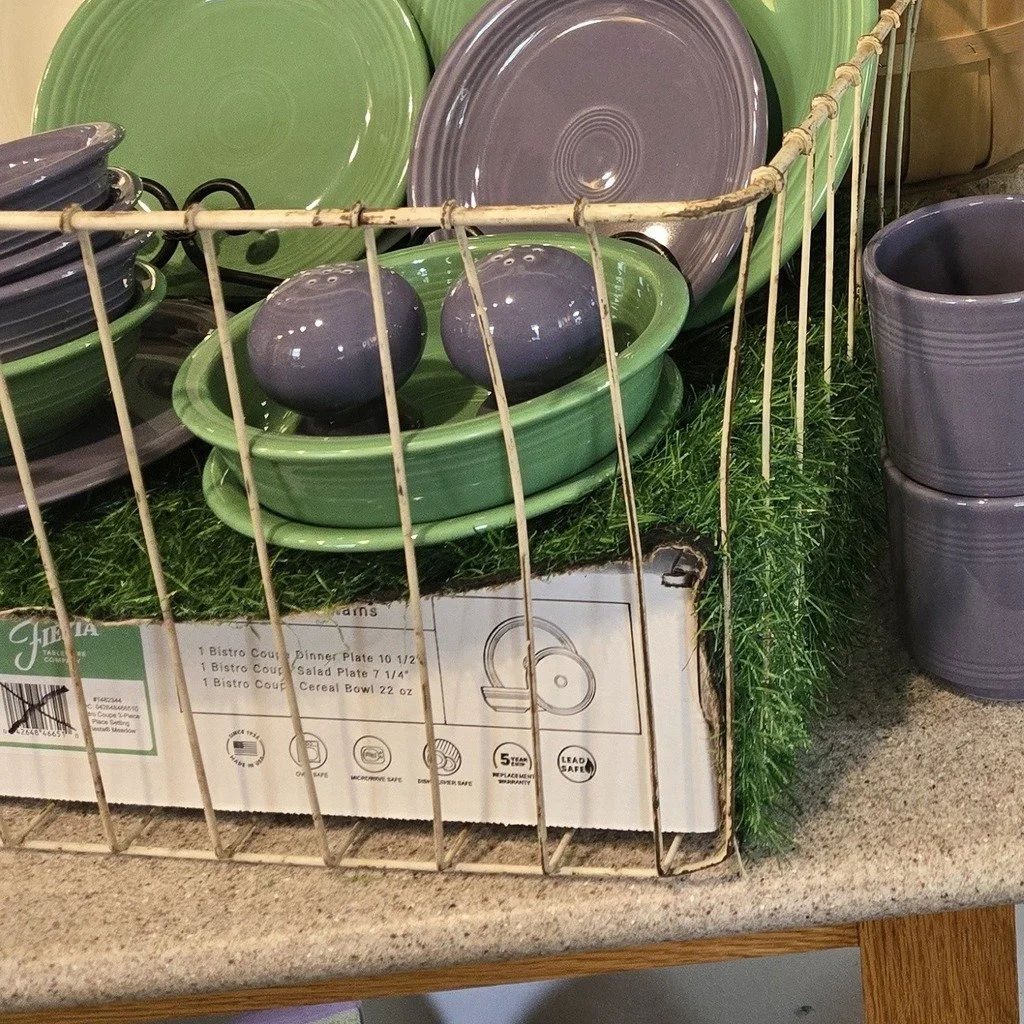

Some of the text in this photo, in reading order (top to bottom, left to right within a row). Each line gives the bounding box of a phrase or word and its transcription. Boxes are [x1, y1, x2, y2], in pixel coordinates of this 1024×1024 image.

[8, 619, 99, 671] FIETA
[199, 647, 203, 655] 1
[209, 646, 246, 657] Bistro
[296, 650, 336, 661] Dinner
[343, 652, 374, 662] Plate
[380, 655, 391, 664] 10
[201, 663, 205, 671] 1
[212, 662, 248, 673] Bistro
[253, 664, 283, 676] Coup
[297, 665, 331, 676] Salad
[337, 667, 368, 678] Plate
[373, 669, 379, 678] 7
[203, 677, 413, 696] 1 Bistro Coup Cereal Bowl 22 oz
[500, 753, 510, 766] 5
[561, 756, 586, 765] LEAD
[561, 765, 585, 774] SAFE
